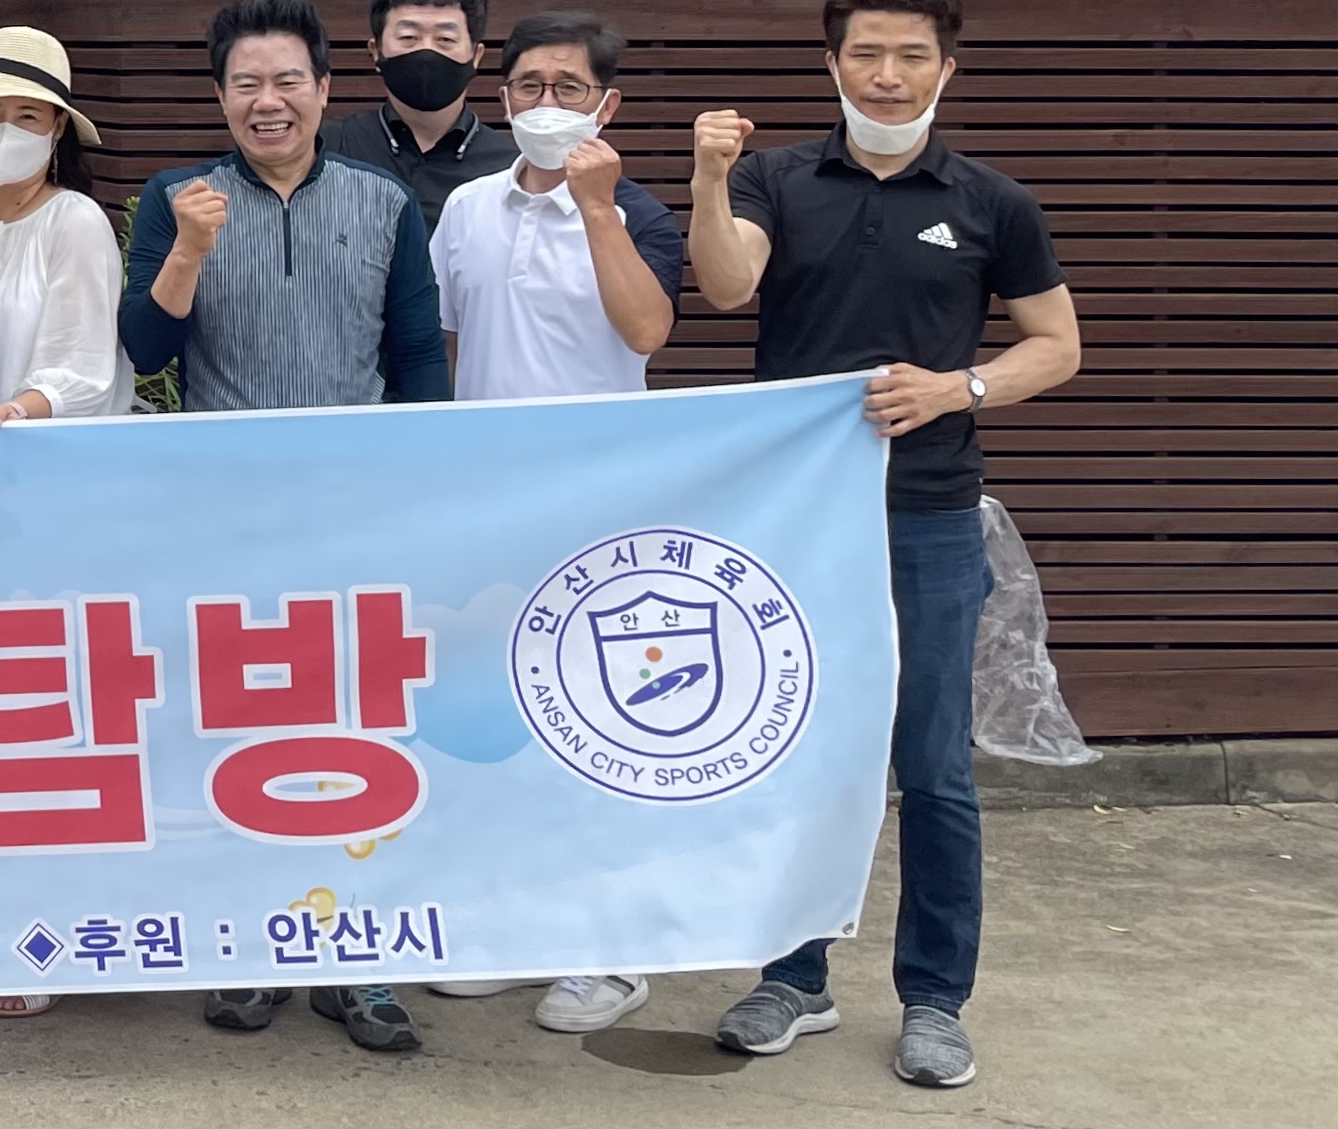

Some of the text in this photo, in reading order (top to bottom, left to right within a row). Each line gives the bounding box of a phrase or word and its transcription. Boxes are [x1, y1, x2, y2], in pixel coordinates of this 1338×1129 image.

[528, 540, 790, 636] 안산시체육회
[531, 660, 800, 787] ANSAN CITY SPORTS COUNCIL
[74, 914, 184, 971] 후원
[266, 906, 445, 966] 안산시
